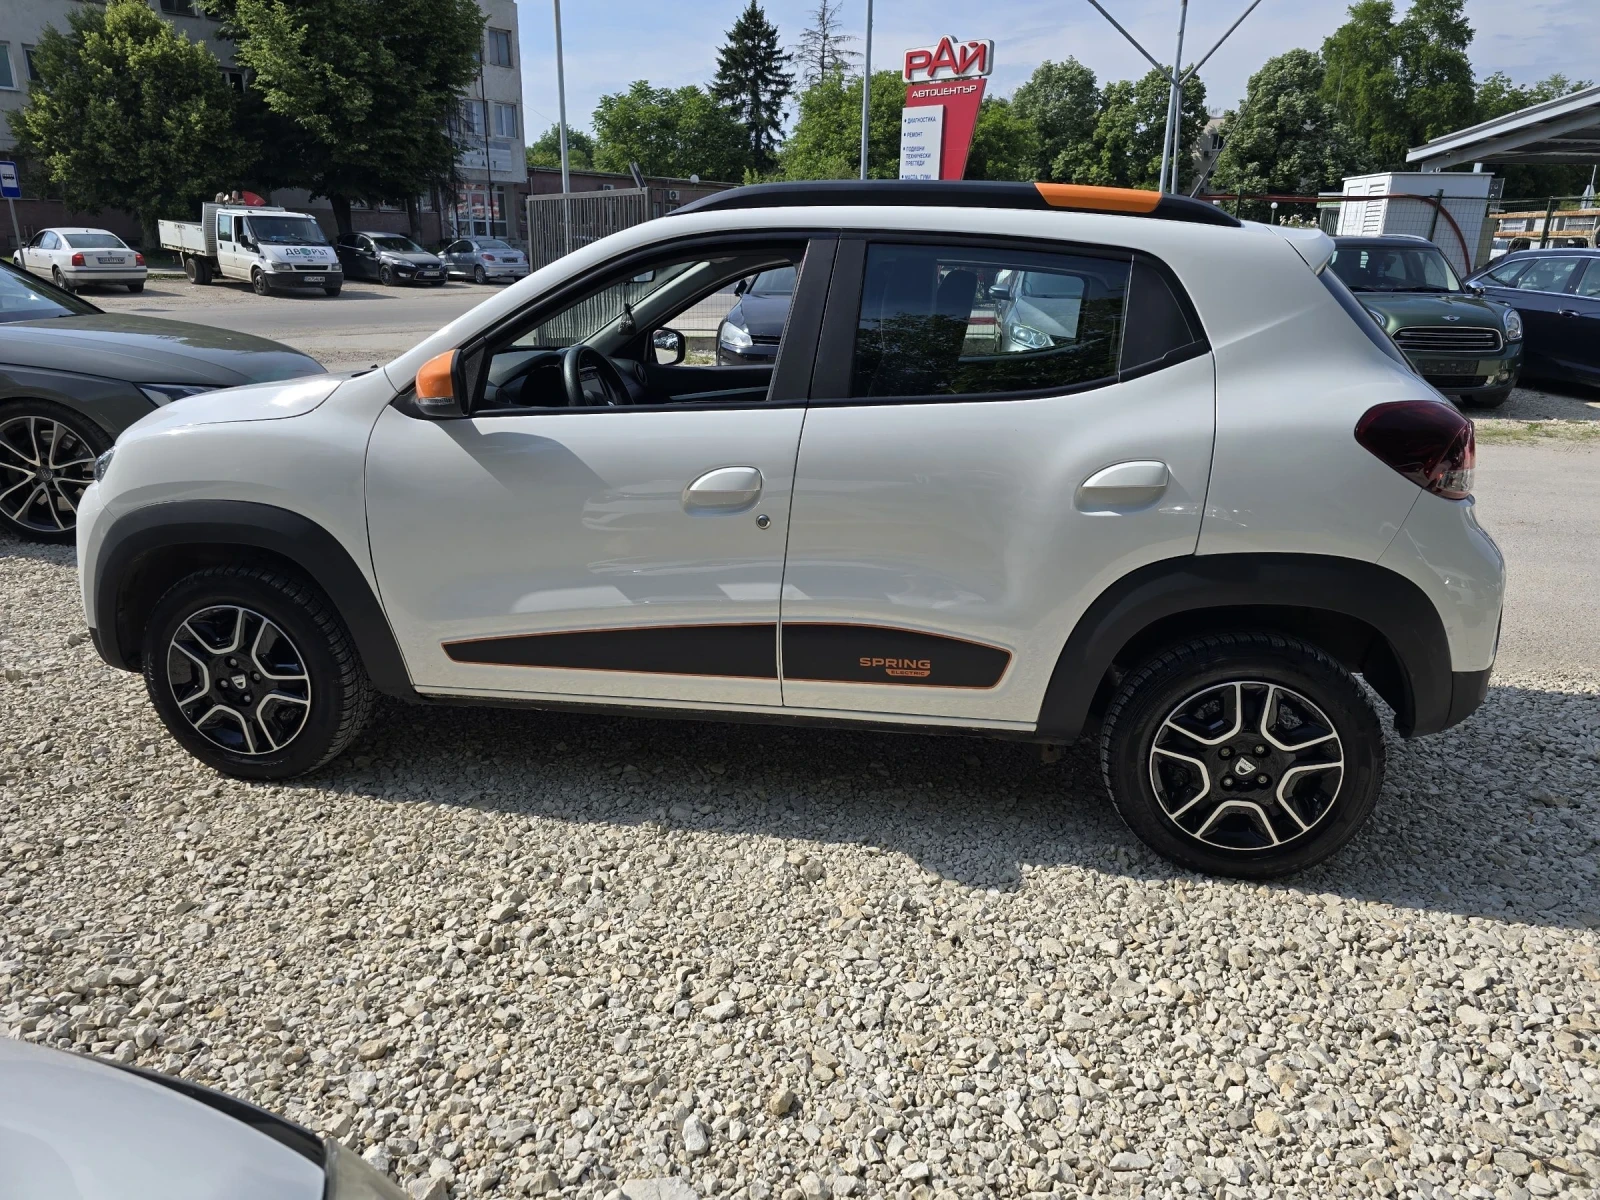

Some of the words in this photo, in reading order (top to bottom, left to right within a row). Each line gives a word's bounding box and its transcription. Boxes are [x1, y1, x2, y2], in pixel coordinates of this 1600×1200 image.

[904, 36, 987, 80] РАЙ
[911, 84, 977, 98] АВТОЦЕНТЪР
[907, 116, 937, 124] ДИАГНОСТИКА
[859, 657, 931, 669] SPRING
